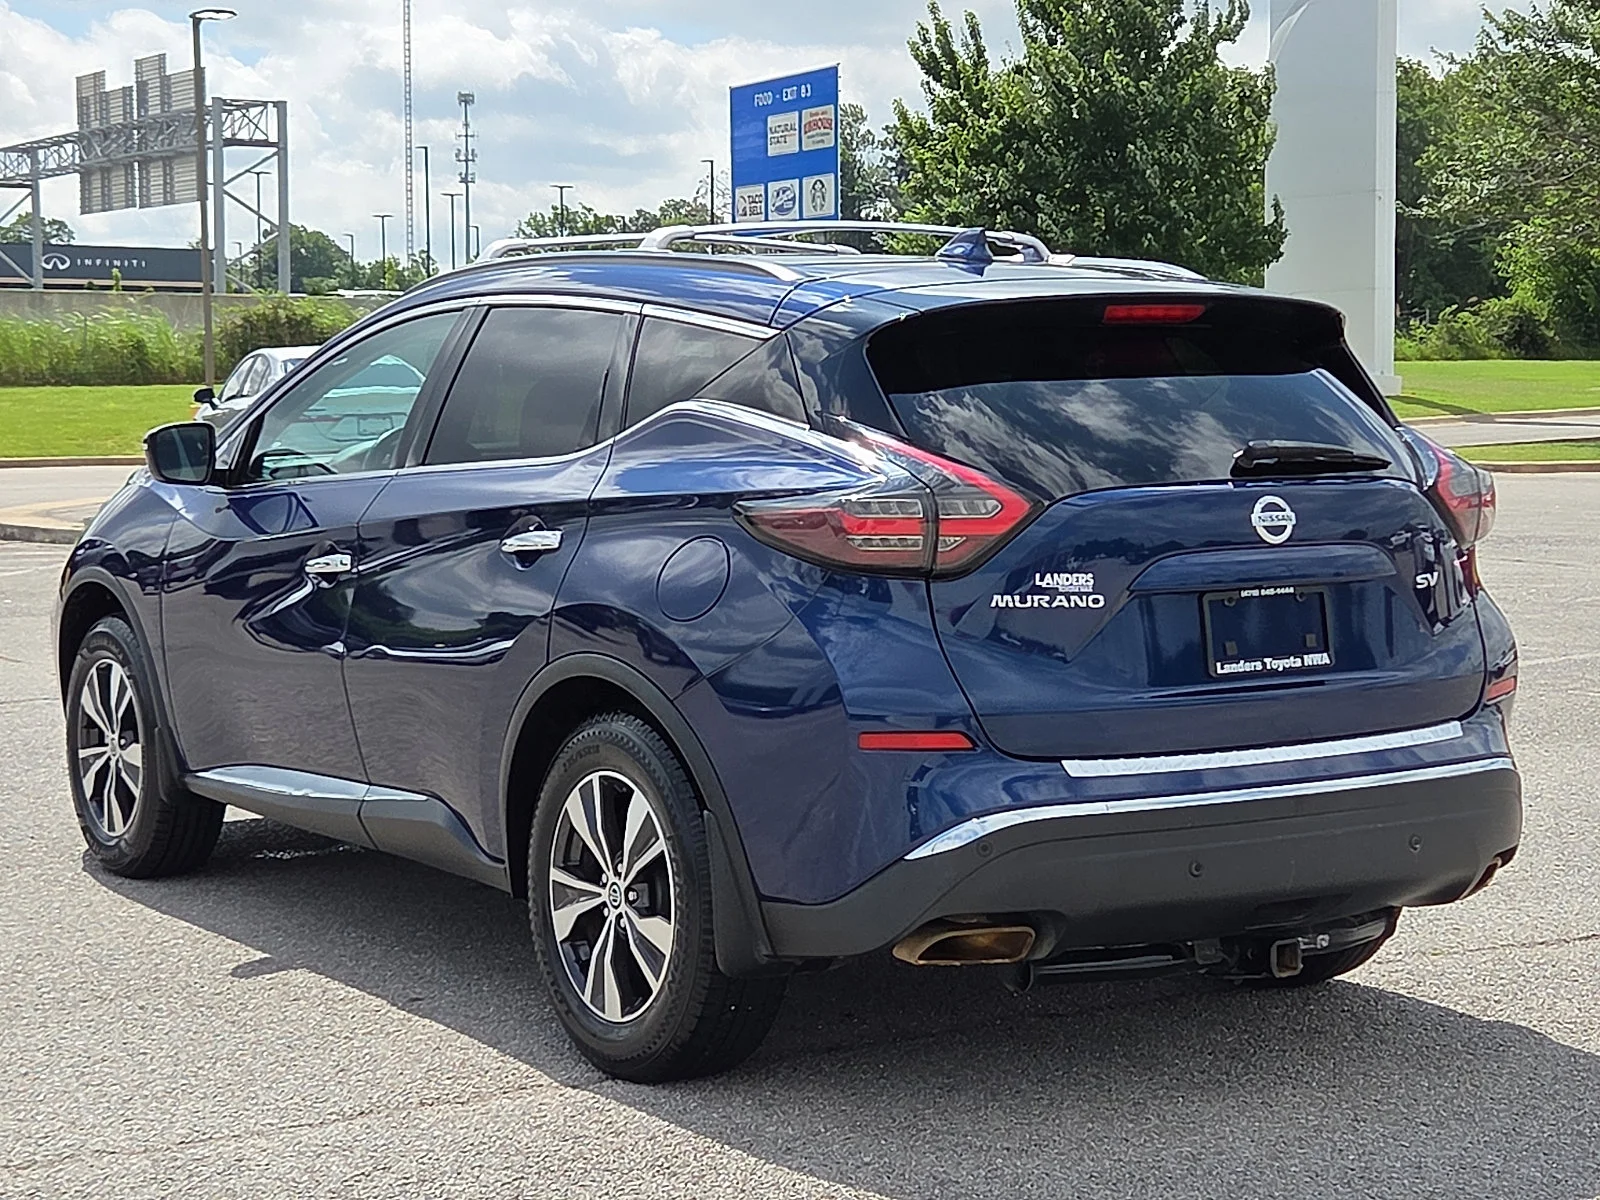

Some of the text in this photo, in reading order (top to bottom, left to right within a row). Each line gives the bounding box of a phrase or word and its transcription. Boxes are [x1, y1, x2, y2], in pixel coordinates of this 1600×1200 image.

[754, 91, 773, 107] FOOD
[782, 86, 798, 102] EXIT
[769, 121, 797, 135] NATURAL
[769, 135, 787, 146] STATE
[747, 193, 763, 204] TACO
[748, 205, 763, 216] BELL
[76, 258, 147, 268] INFINITI
[1257, 514, 1293, 523] NISSAN
[1035, 573, 1094, 586] LANDERS
[1415, 571, 1439, 589] SV
[990, 594, 1105, 608] MURANO
[1215, 652, 1331, 674] Landers Toyota NWA
